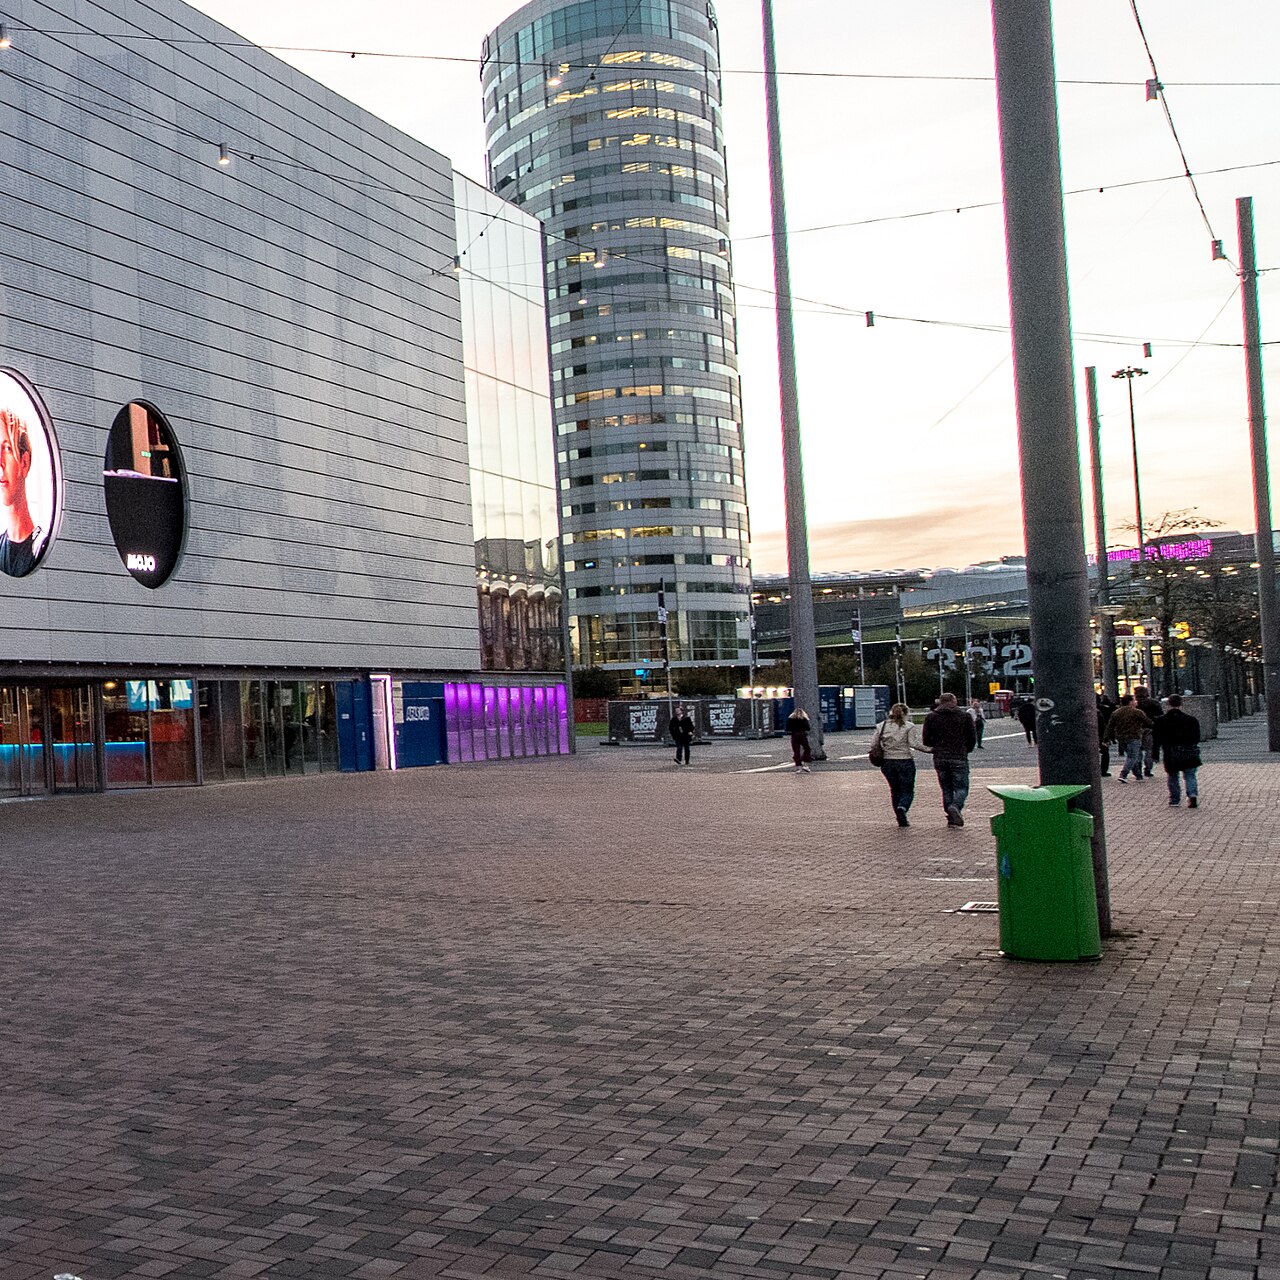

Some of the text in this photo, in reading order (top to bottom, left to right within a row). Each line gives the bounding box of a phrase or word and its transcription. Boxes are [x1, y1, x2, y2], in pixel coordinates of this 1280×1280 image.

[127, 554, 156, 571] MOJO
[630, 715, 656, 723] DDDY
[710, 712, 734, 720] DDDY
[630, 722, 657, 731] KNOW
[710, 718, 735, 727] KNOW
